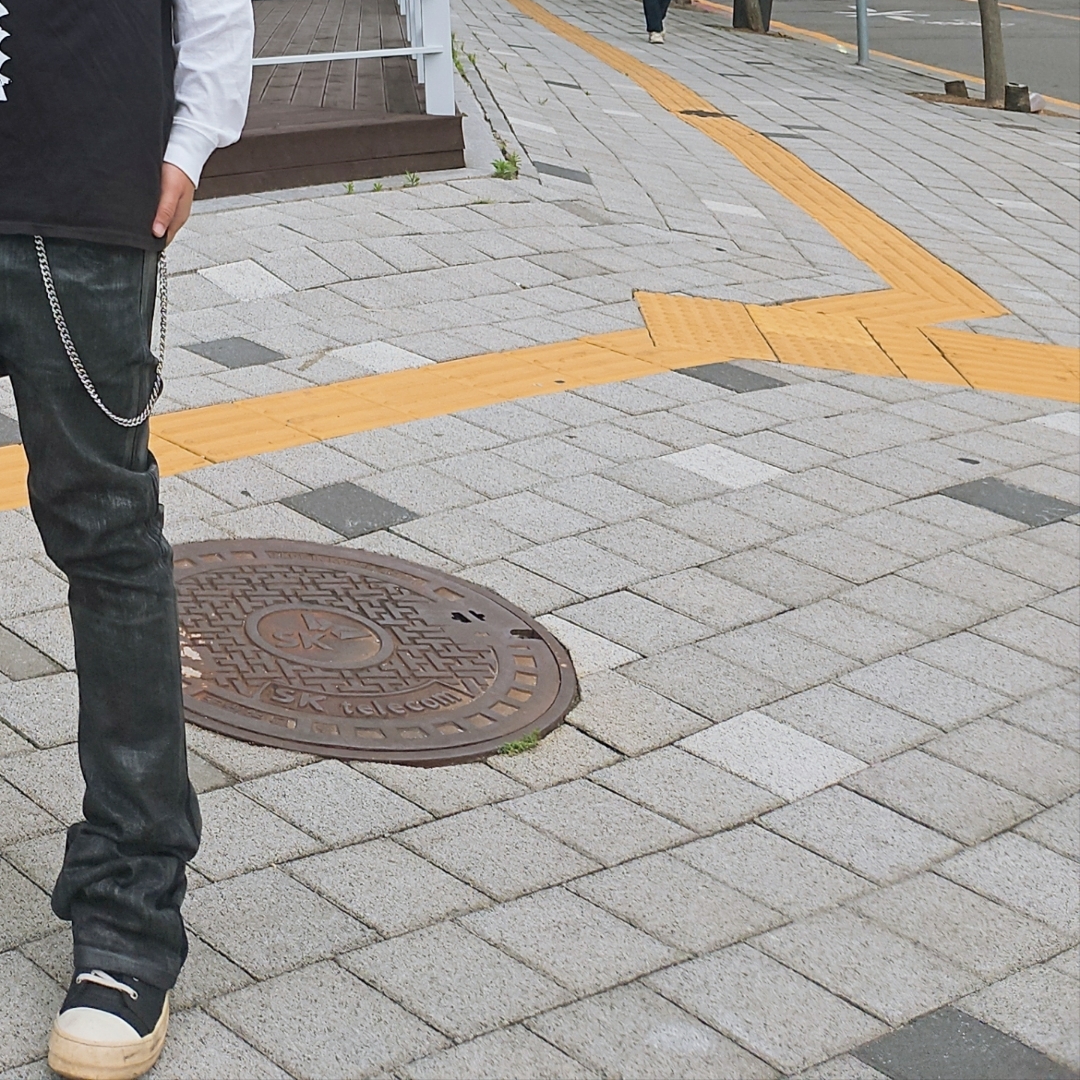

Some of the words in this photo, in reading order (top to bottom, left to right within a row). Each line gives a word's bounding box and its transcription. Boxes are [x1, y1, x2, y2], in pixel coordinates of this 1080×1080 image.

[272, 631, 333, 651] SK
[272, 687, 327, 712] SK
[341, 690, 461, 715] telecom
